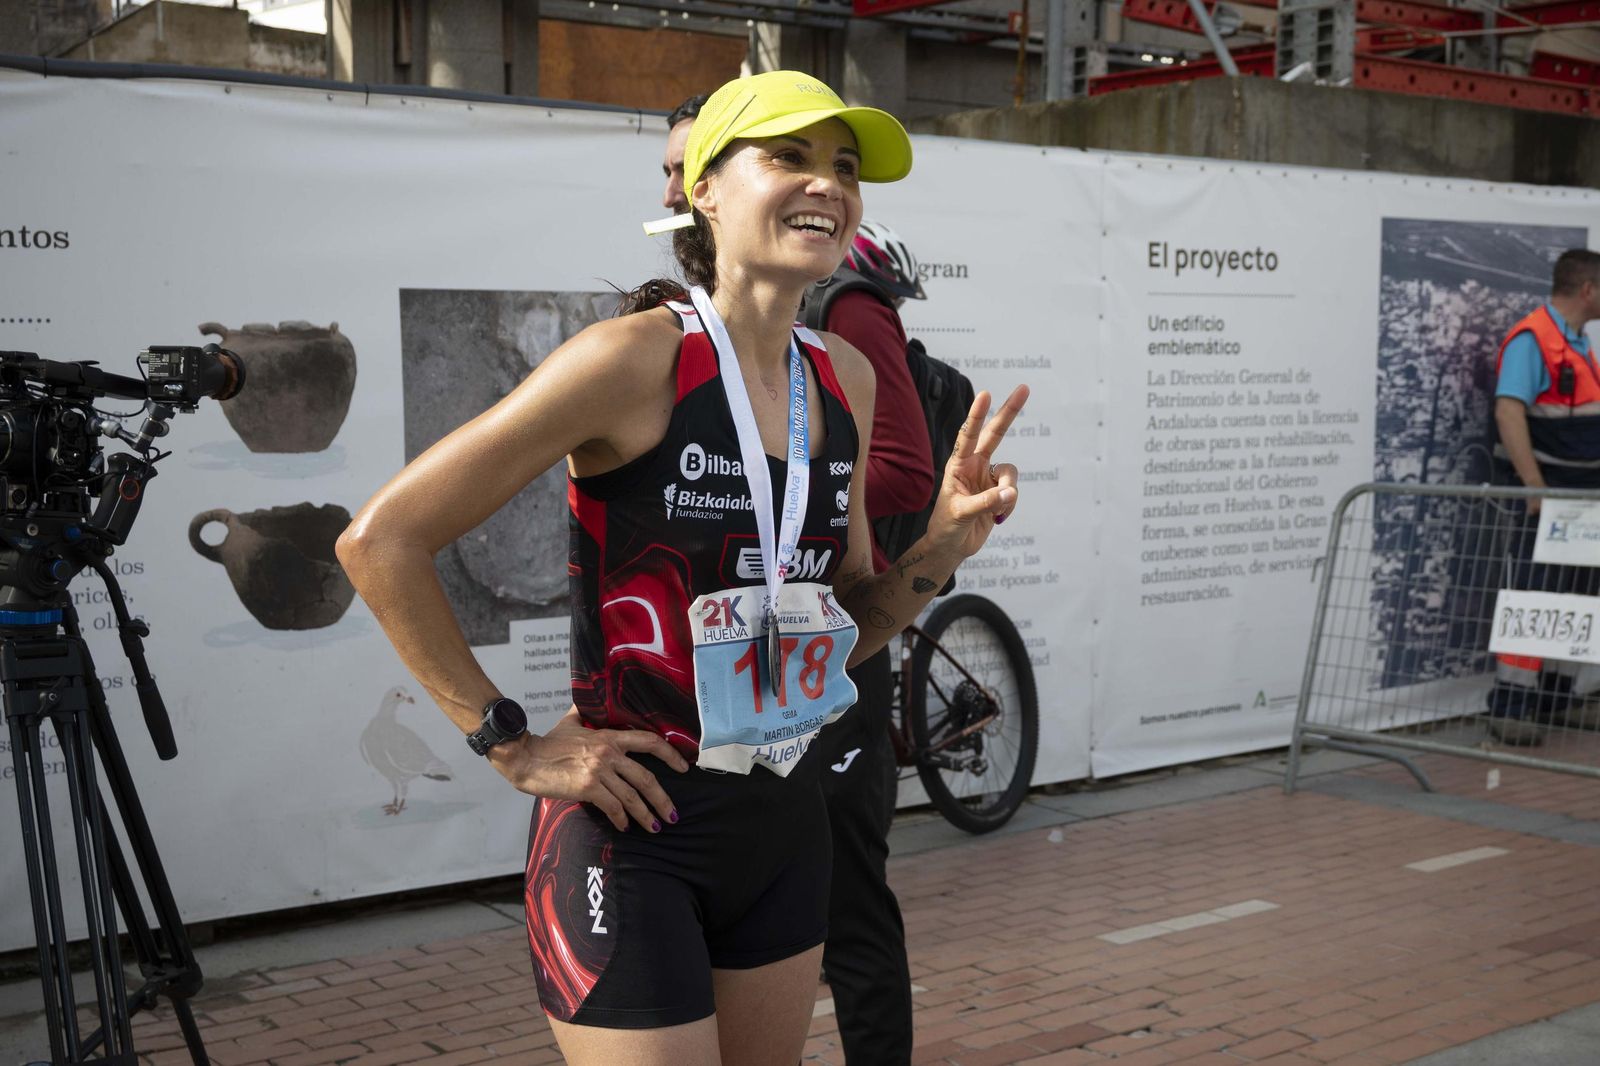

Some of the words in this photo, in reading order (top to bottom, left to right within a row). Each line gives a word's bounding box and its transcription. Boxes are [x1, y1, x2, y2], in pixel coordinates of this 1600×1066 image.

[1148, 241, 1168, 268] El
[1175, 246, 1278, 277] proyecto
[1147, 315, 1169, 332] Un
[1172, 315, 1225, 332] edificio
[1147, 338, 1241, 355] emblemático
[1003, 355, 1051, 368] avalada
[1147, 370, 1165, 386] La
[1170, 369, 1235, 386] Dirección
[1239, 368, 1293, 384] General
[1295, 369, 1312, 384] de
[794, 382, 804, 395] DE
[1147, 391, 1224, 408] Patrimonio
[1227, 391, 1244, 406] de
[1248, 391, 1260, 406] la
[1263, 390, 1301, 405] Junta
[1305, 389, 1321, 404] de
[794, 397, 805, 430] MARZO
[1146, 414, 1217, 431] Andalucía
[1221, 413, 1266, 428] cuenta
[1269, 412, 1293, 426] con
[1297, 410, 1309, 425] la
[1312, 409, 1359, 424] licencia
[794, 431, 805, 447] DE
[1144, 437, 1163, 453] de
[1166, 435, 1205, 452] obras
[1209, 435, 1241, 453] para
[684, 450, 748, 477] Bilba
[794, 449, 805, 460] 10
[1144, 456, 1235, 475] destinándose
[1238, 458, 1247, 470] a
[1251, 454, 1264, 469] la
[1267, 453, 1309, 469] futura
[1143, 477, 1230, 497] institucional
[1233, 476, 1254, 491] del
[1258, 474, 1318, 491] Gobierno
[785, 475, 800, 521] Huelva
[1143, 500, 1199, 518] andaluz
[1203, 501, 1221, 515] en
[1225, 497, 1273, 514] Huelva.
[1278, 495, 1295, 509] De
[676, 508, 724, 520] fundazioa
[1142, 524, 1189, 541] forma,
[1192, 525, 1208, 537] se
[1212, 517, 1275, 535] consolida
[1279, 515, 1291, 530] la
[1141, 544, 1208, 563] onubense
[114, 558, 145, 575] los
[1141, 561, 1246, 585] administrativo,
[1248, 558, 1265, 574] de
[1141, 585, 1233, 606] restauración.
[703, 595, 747, 629] 21K
[777, 615, 810, 625] HUELVA
[704, 627, 748, 642] HUELVA
[1501, 607, 1592, 643] PRENSA
[734, 635, 834, 713] 178
[782, 709, 798, 720] GEMA
[764, 725, 794, 742] MARTIN
[795, 715, 825, 734] BORGAS
